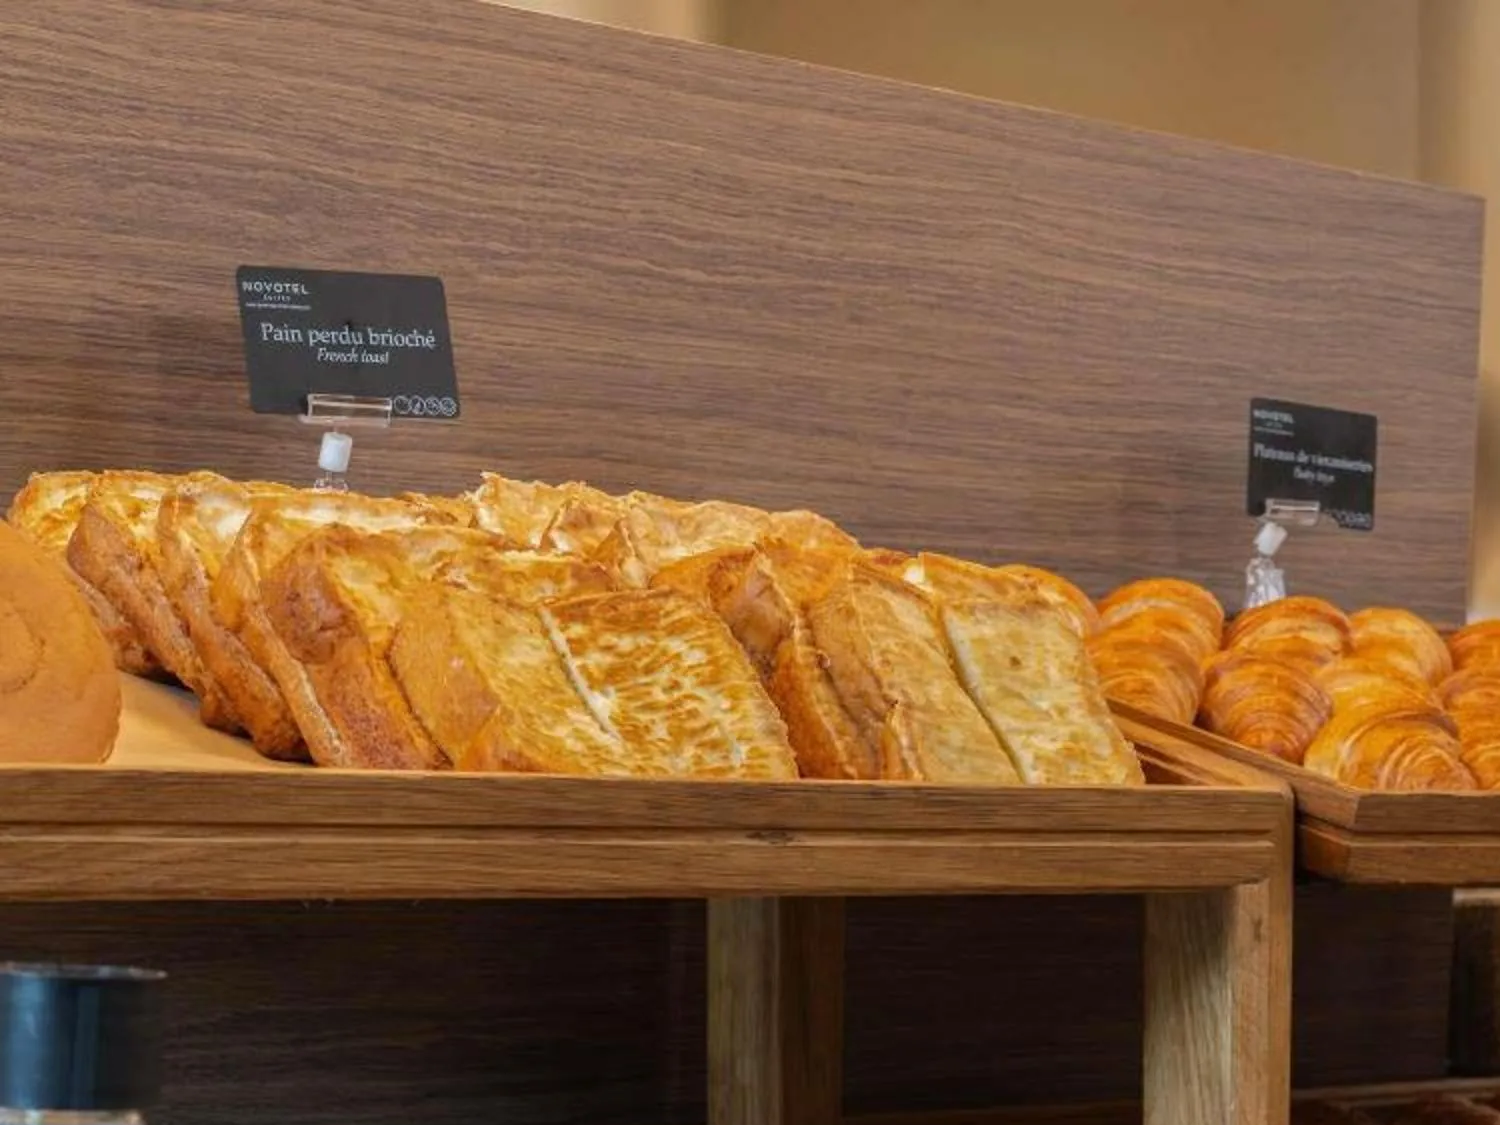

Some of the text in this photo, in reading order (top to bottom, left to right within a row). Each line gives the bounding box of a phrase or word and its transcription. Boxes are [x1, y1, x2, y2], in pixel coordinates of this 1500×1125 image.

[242, 281, 310, 295] NOVOTEL
[260, 322, 436, 349] Pain perdu brioché
[317, 348, 358, 363] French
